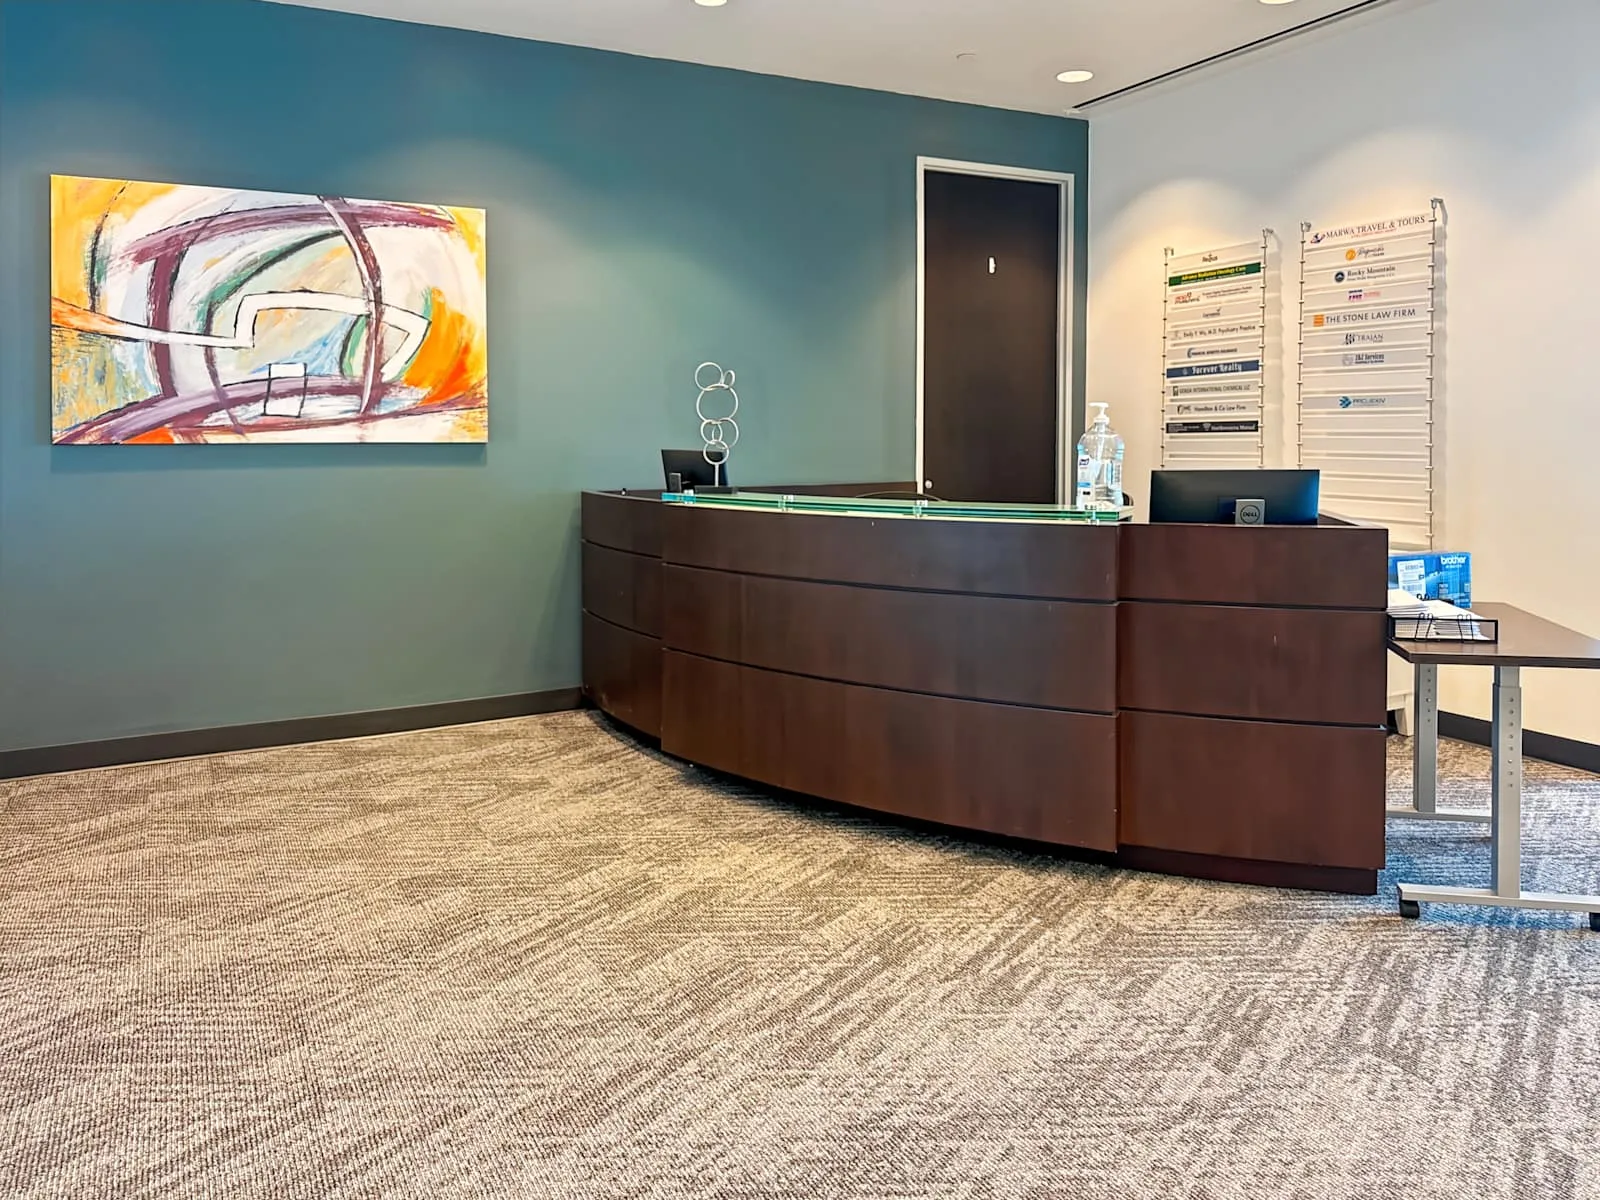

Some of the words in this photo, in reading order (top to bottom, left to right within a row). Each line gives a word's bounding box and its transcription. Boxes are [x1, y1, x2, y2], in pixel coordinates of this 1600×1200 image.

[1326, 228, 1355, 239] MARWA
[1356, 223, 1387, 234] TRAVEL
[1388, 221, 1396, 229] &
[1397, 215, 1425, 228] TOURS
[1347, 270, 1365, 278] Rocky
[1366, 264, 1396, 275] Mountain
[1326, 316, 1341, 324] THE
[1343, 313, 1369, 322] STONE
[1371, 310, 1391, 320] LAW
[1393, 308, 1416, 317] FIRM
[1192, 365, 1218, 374] Forever
[1219, 362, 1242, 372] Realty
[1440, 555, 1467, 565] brother
